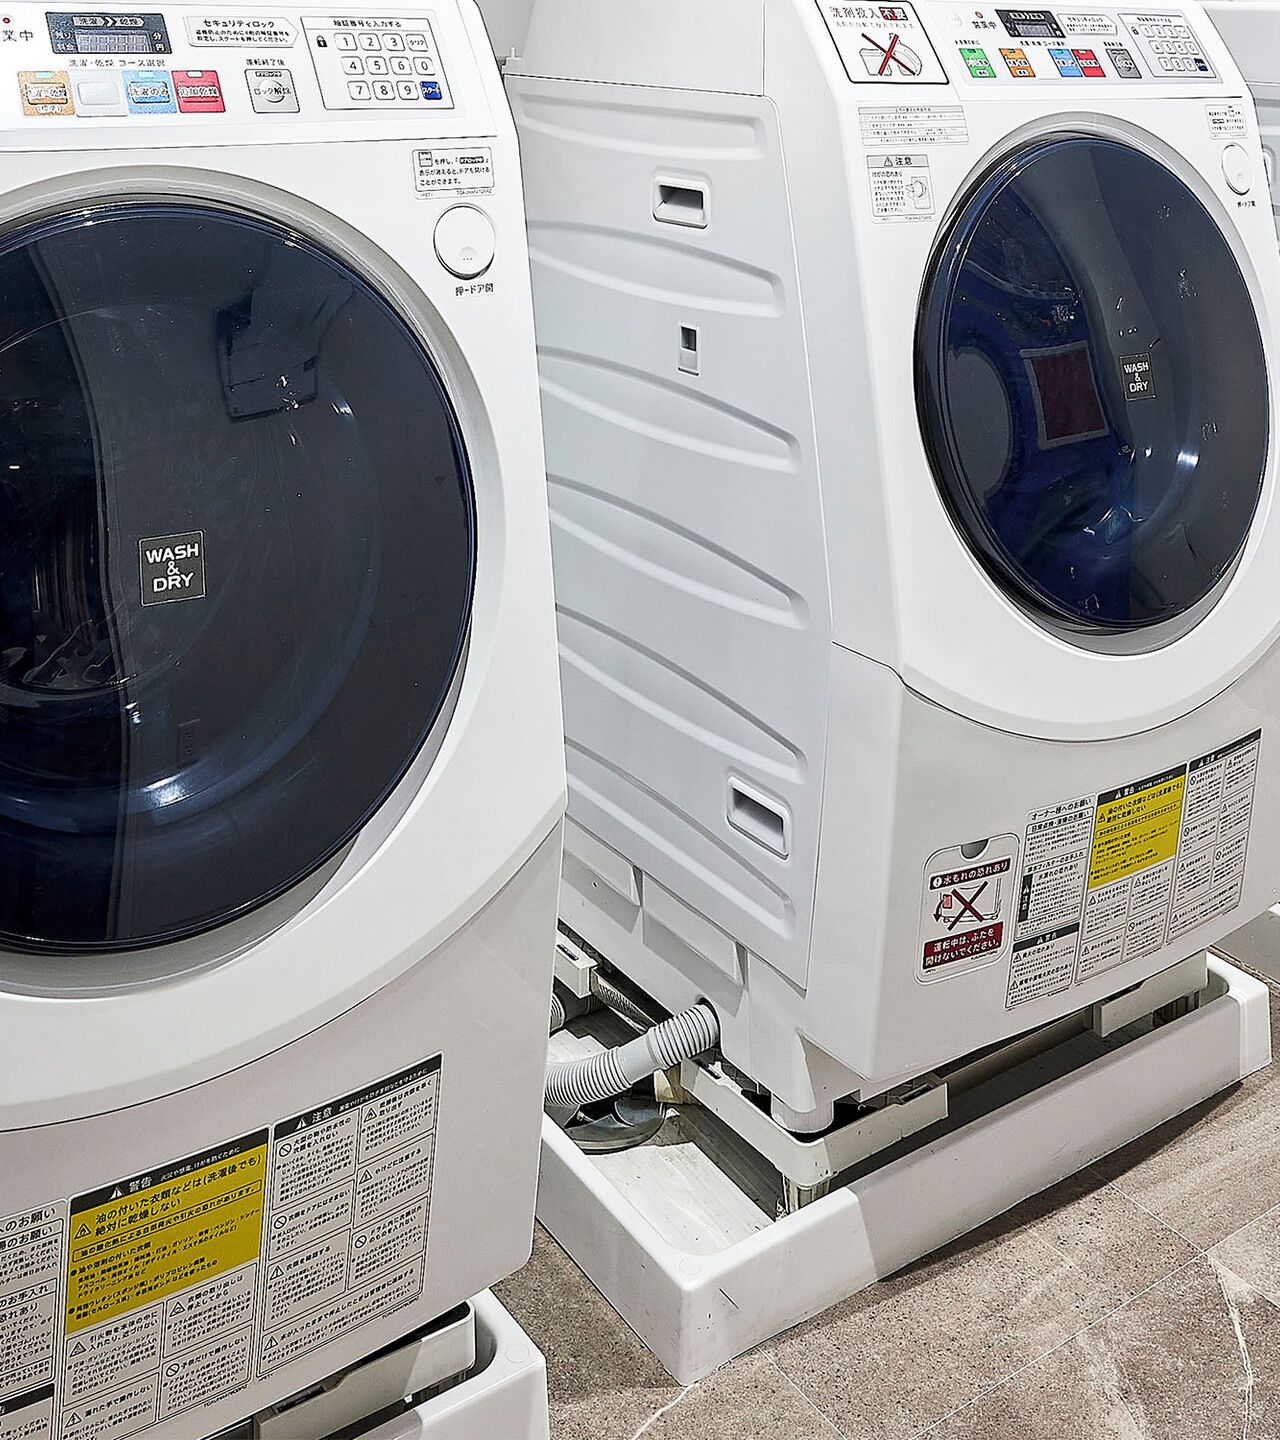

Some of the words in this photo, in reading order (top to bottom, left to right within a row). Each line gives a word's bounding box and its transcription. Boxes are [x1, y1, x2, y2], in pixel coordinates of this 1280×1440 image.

[830, 6, 880, 19] 洗剤投入
[203, 19, 275, 28] セキュリティロック
[343, 38, 349, 46] 1
[368, 38, 374, 46] 2
[391, 38, 398, 46] 3
[350, 61, 357, 70] 4
[374, 61, 381, 70] 5
[398, 61, 405, 70] 6
[421, 61, 428, 70] 0
[357, 86, 362, 95] 7
[380, 86, 388, 95] 8
[404, 86, 411, 95] 9
[895, 157, 912, 166] 注意
[1124, 362, 1149, 373] WASH
[1135, 372, 1141, 381] &
[1130, 381, 1148, 392] DRY
[146, 543, 199, 563] WASH
[167, 561, 180, 575] &
[153, 572, 194, 592] DRY
[943, 861, 1008, 885] 水もれの恐れあり
[934, 928, 994, 952] 運転中は、ふたを
[926, 939, 999, 966] 開けないでください。
[312, 1107, 333, 1123] 注意
[95, 1199, 182, 1236] 絶対に乾燥しない
